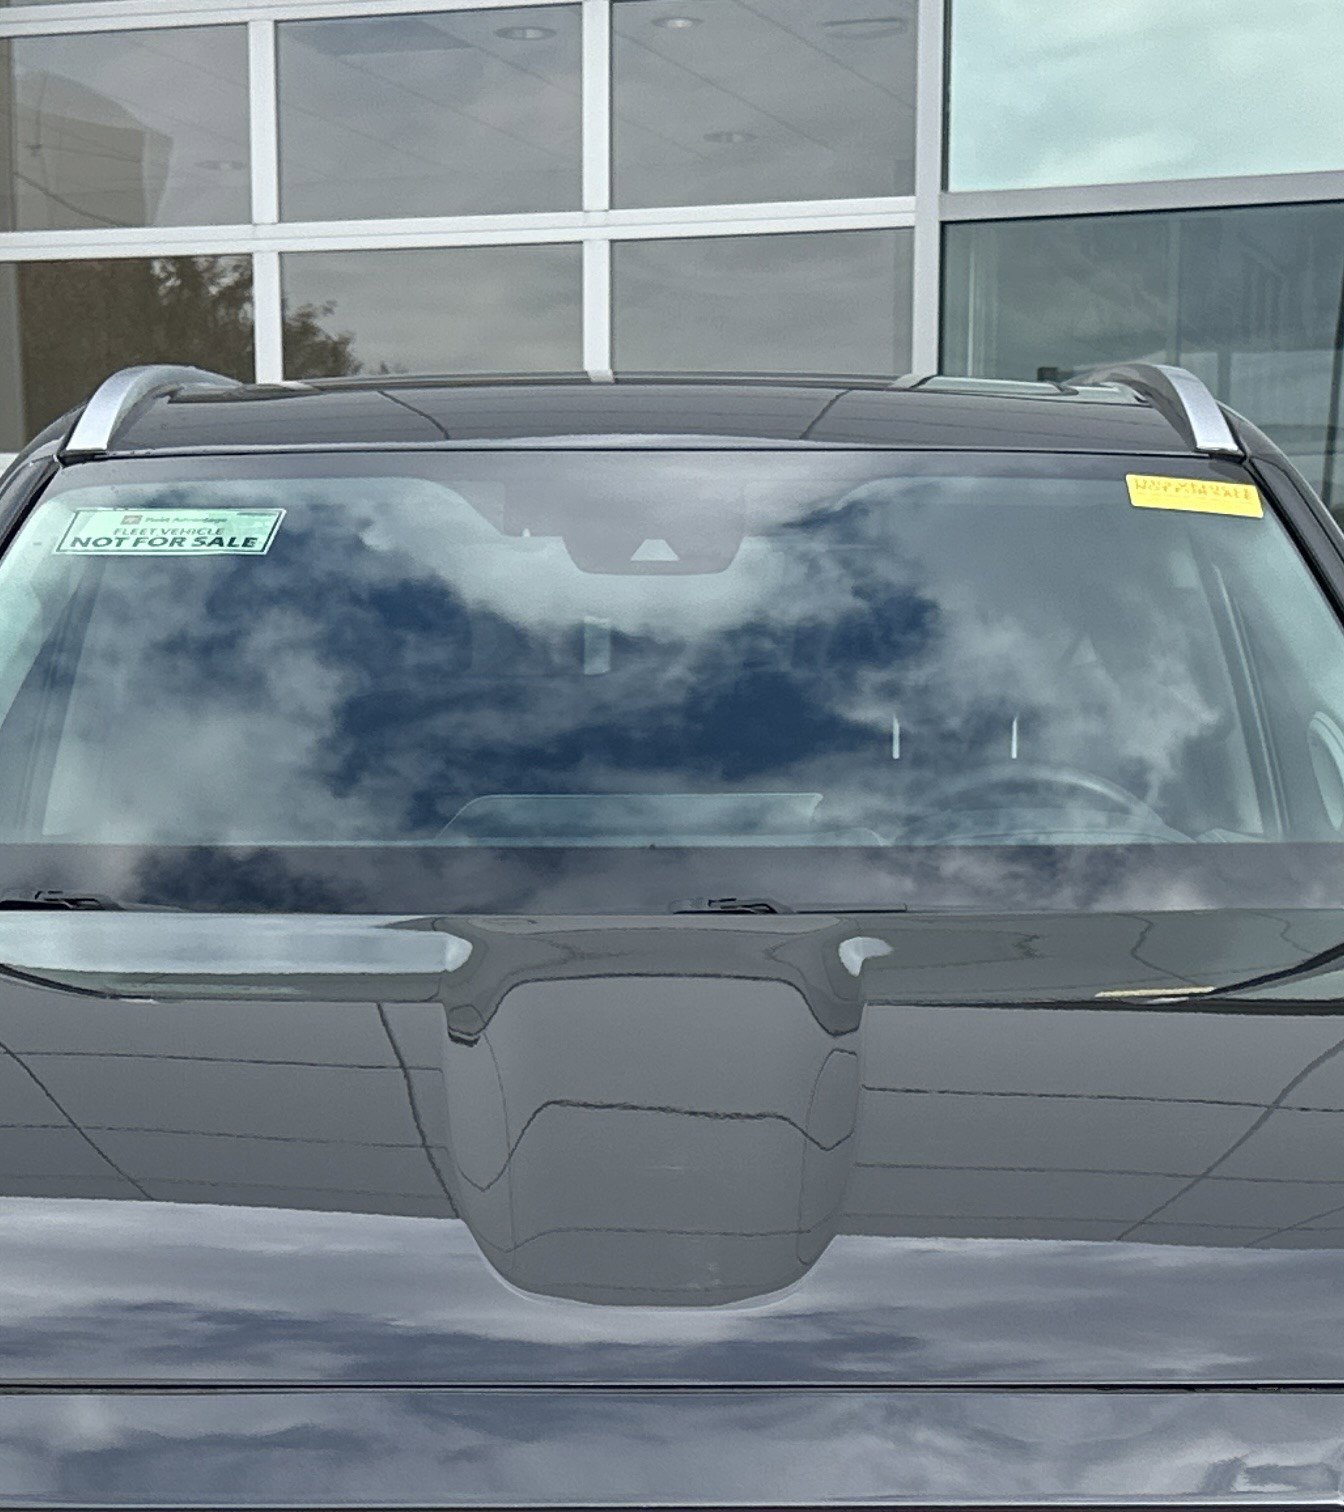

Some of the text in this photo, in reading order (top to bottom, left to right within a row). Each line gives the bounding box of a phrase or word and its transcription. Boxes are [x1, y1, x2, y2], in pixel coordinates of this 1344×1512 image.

[113, 527, 225, 536] FLEET VEHICLE
[70, 536, 258, 548] NOT FOR SALE
